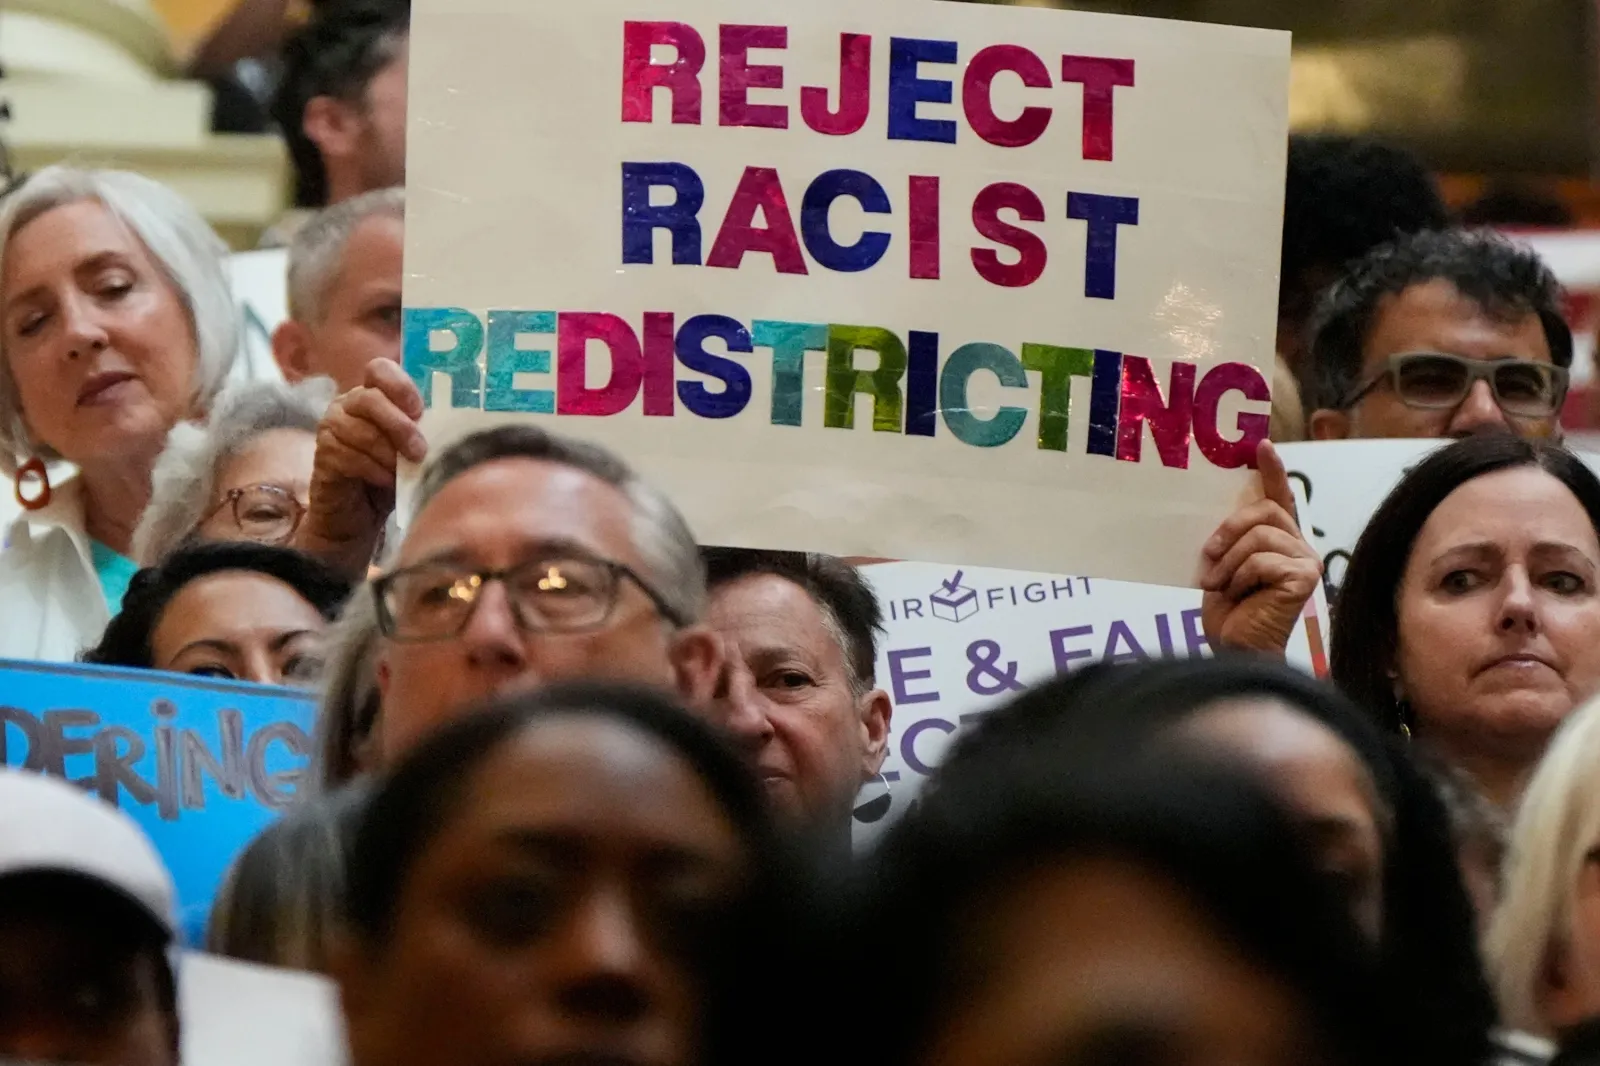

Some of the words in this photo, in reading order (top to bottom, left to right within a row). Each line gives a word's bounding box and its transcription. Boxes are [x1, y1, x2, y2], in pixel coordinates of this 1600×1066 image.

[621, 20, 1135, 161] REJECT
[621, 161, 1139, 300] RACIST
[402, 307, 1273, 469] REDISTRICTING
[889, 598, 924, 621] IR
[987, 575, 1093, 609] FIGHT
[873, 646, 941, 706] E
[965, 638, 1030, 696] &
